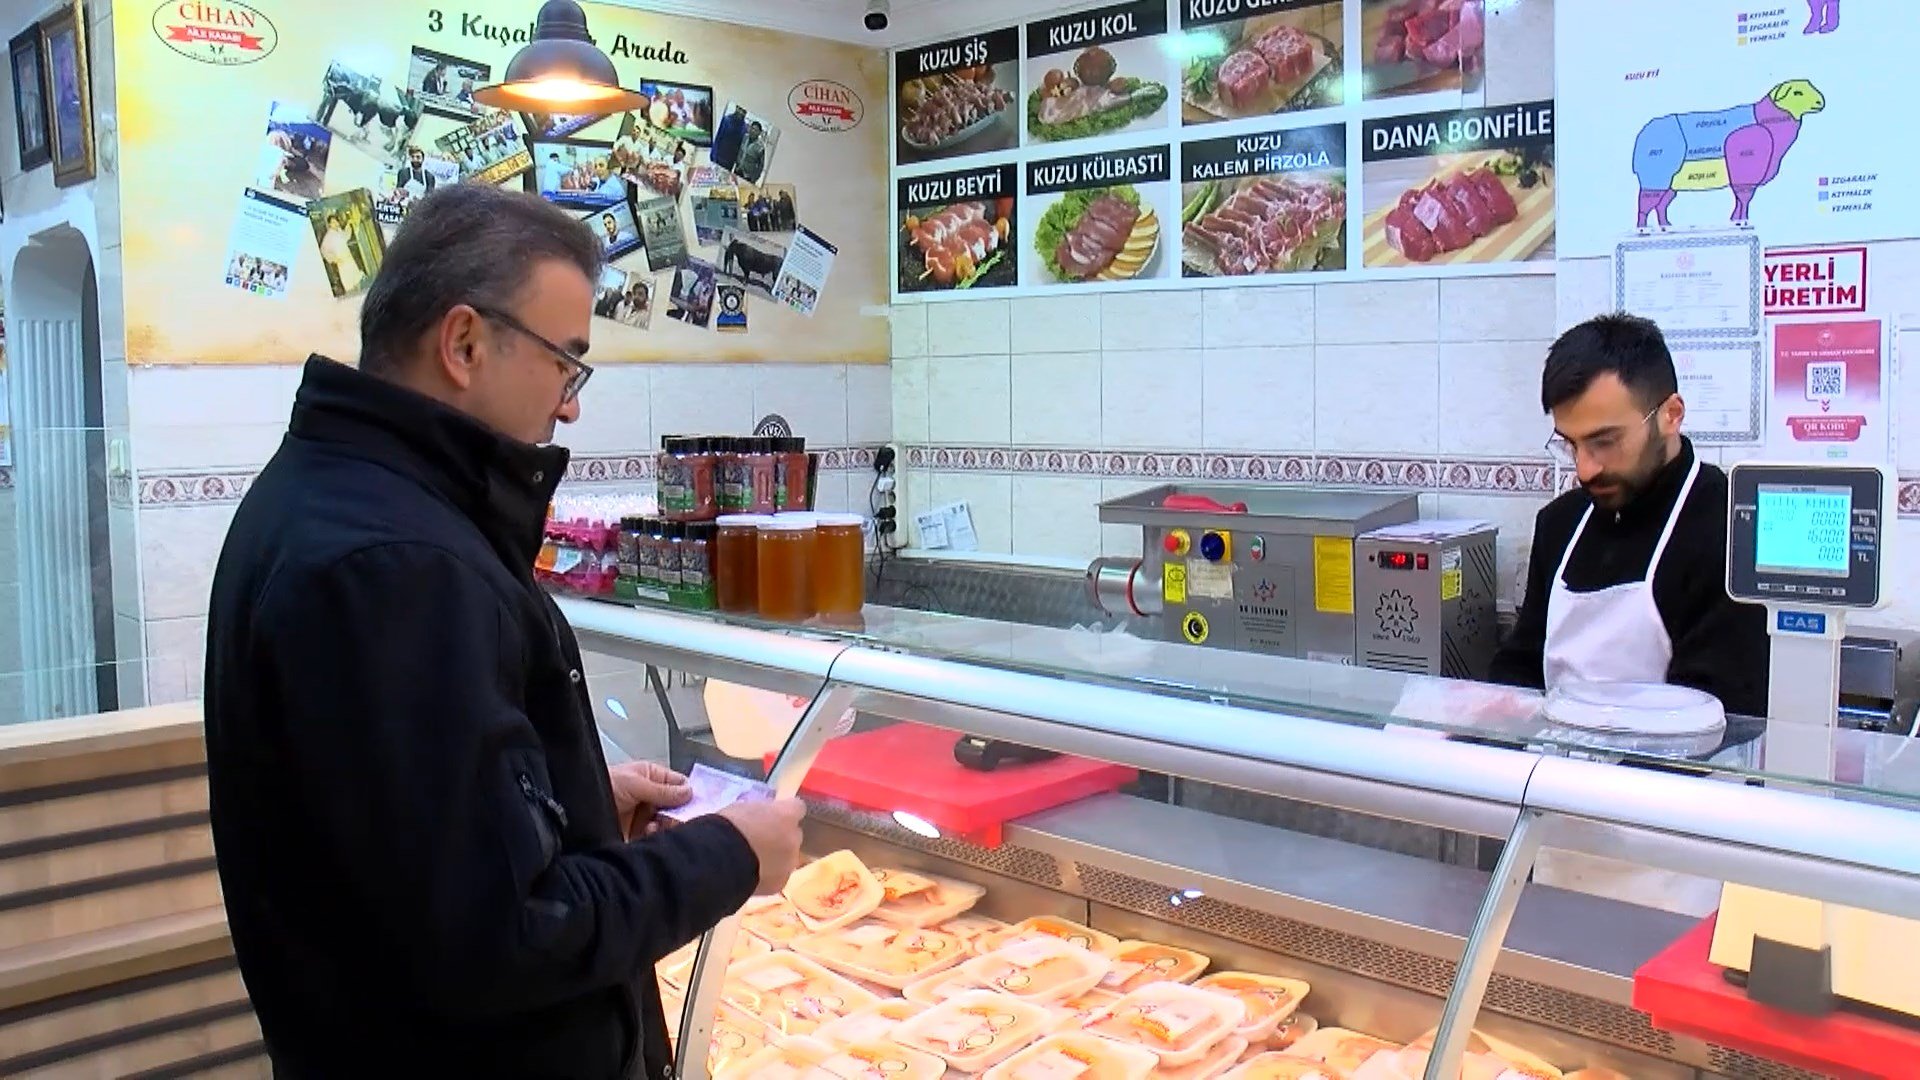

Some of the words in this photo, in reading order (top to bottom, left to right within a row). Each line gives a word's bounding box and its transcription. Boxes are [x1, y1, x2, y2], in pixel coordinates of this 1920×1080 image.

[428, 9, 444, 32] 3
[461, 13, 536, 47] Kuşa
[610, 33, 689, 64] Arada
[1050, 24, 1096, 46] KUZU
[1101, 13, 1138, 38] KOL
[919, 48, 961, 71] KUZU
[964, 39, 988, 66] ŞİŞ
[803, 84, 850, 103] CİHAN
[1372, 122, 1440, 151] DANA
[1447, 106, 1552, 143] BONFİLE
[1236, 135, 1282, 153] KUZU
[1033, 164, 1078, 186] KUZU
[1082, 153, 1164, 181] KÜLBASTI
[1192, 159, 1250, 178] KALEM
[1254, 151, 1330, 172] PİRZOLA
[908, 179, 951, 202] KUZU
[956, 170, 1001, 196] BEYTİ
[1764, 257, 1834, 282] YERLİ
[1764, 282, 1856, 306] ÜRETİM
[1859, 515, 1870, 526] kg
[1858, 552, 1869, 562] TL
[1782, 615, 1820, 629] CAS
